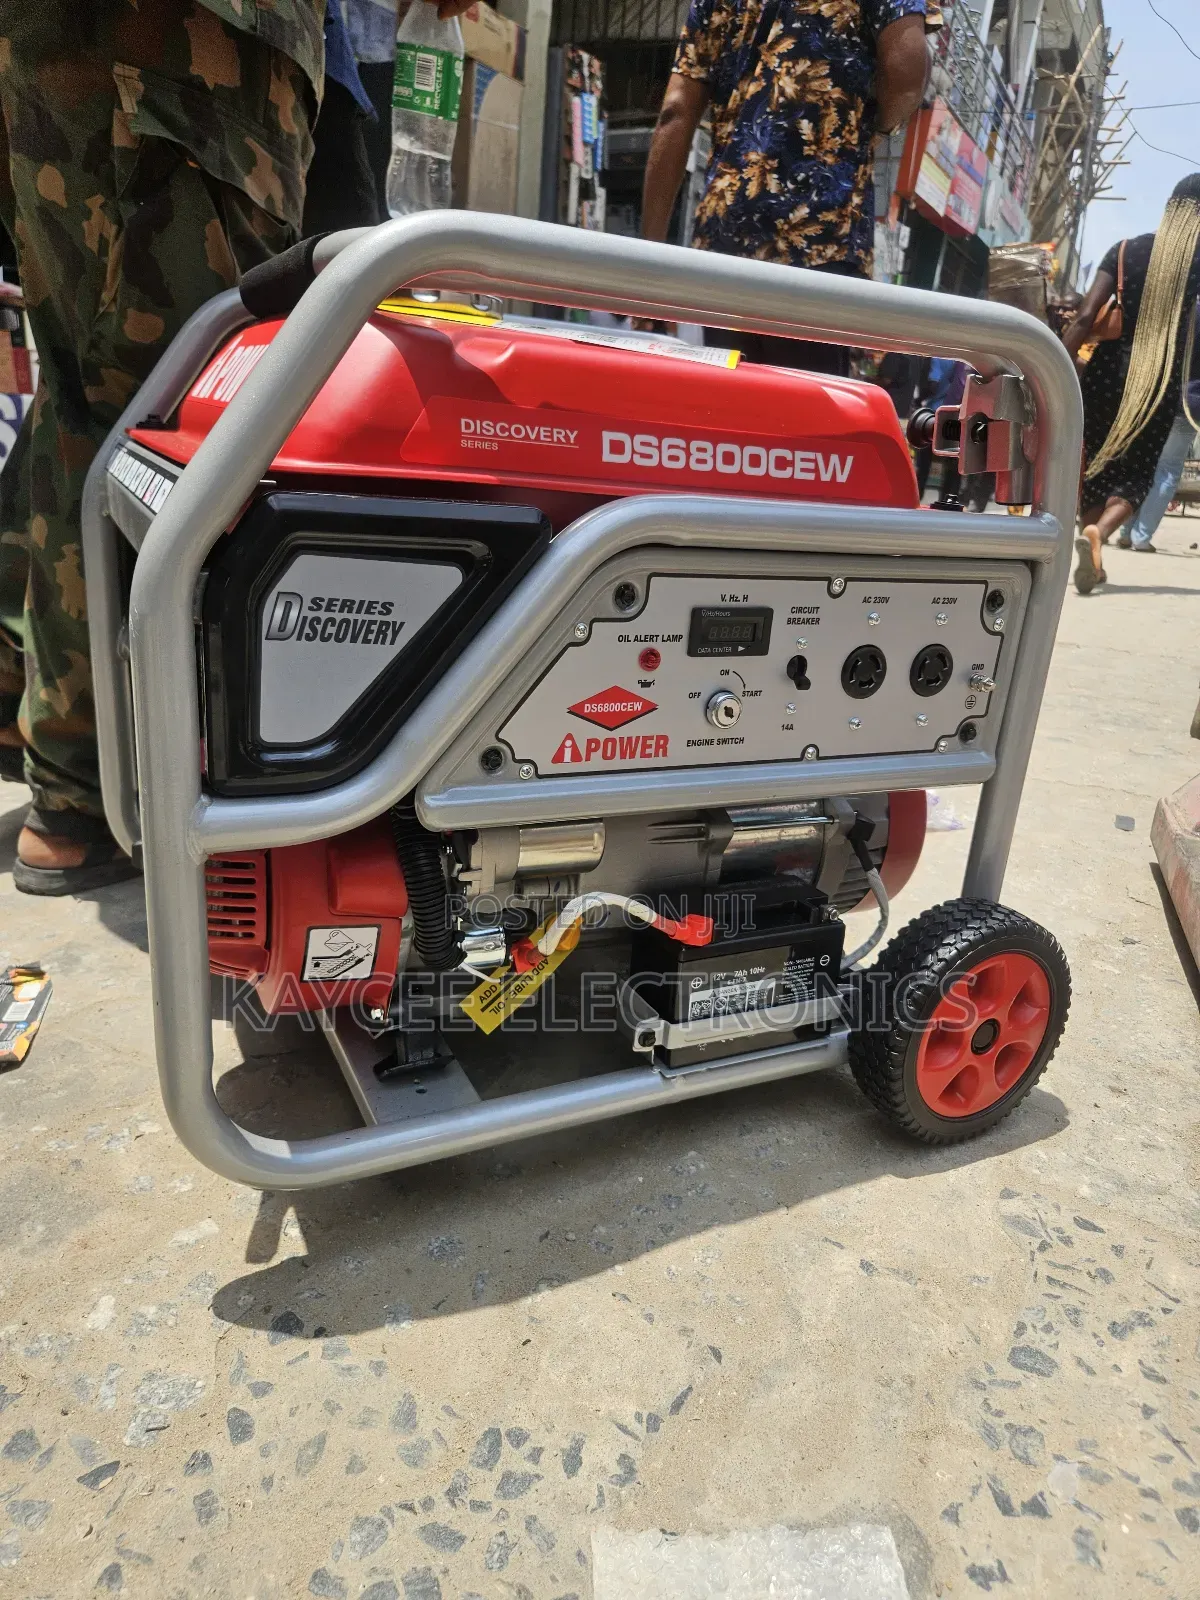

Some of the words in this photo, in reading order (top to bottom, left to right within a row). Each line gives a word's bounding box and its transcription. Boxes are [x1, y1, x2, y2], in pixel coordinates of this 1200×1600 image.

[460, 418, 579, 444] DISCOVERY
[460, 439, 499, 451] SERIES
[602, 431, 854, 483] DS6800CEW
[742, 594, 749, 602] H
[862, 596, 872, 604] AC
[873, 596, 890, 604] 230V
[931, 597, 941, 605] AC
[941, 597, 958, 605] 230V
[308, 596, 395, 617] SERIES
[790, 606, 820, 615] CIRCUIT
[264, 591, 406, 646] DISCOVERY
[786, 617, 820, 626] BREAKER
[617, 635, 631, 643] OIL
[633, 634, 660, 643] ALERT
[661, 634, 684, 643] LAMP
[713, 646, 732, 654] CENTER
[971, 663, 985, 671] GND
[688, 691, 702, 699] OFF
[741, 690, 763, 698] START
[584, 702, 643, 714] DS6800CEW
[781, 723, 794, 731] 14A
[686, 738, 715, 747] ENGINE
[716, 737, 745, 746] SWITCH
[531, 958, 549, 976] ADD
[712, 973, 727, 982] 12V
[734, 969, 748, 977] 7Ah
[749, 966, 766, 975] 10Hr
[509, 975, 533, 999] LUBE
[478, 984, 498, 1004] ADD
[489, 1001, 506, 1015] OIL
